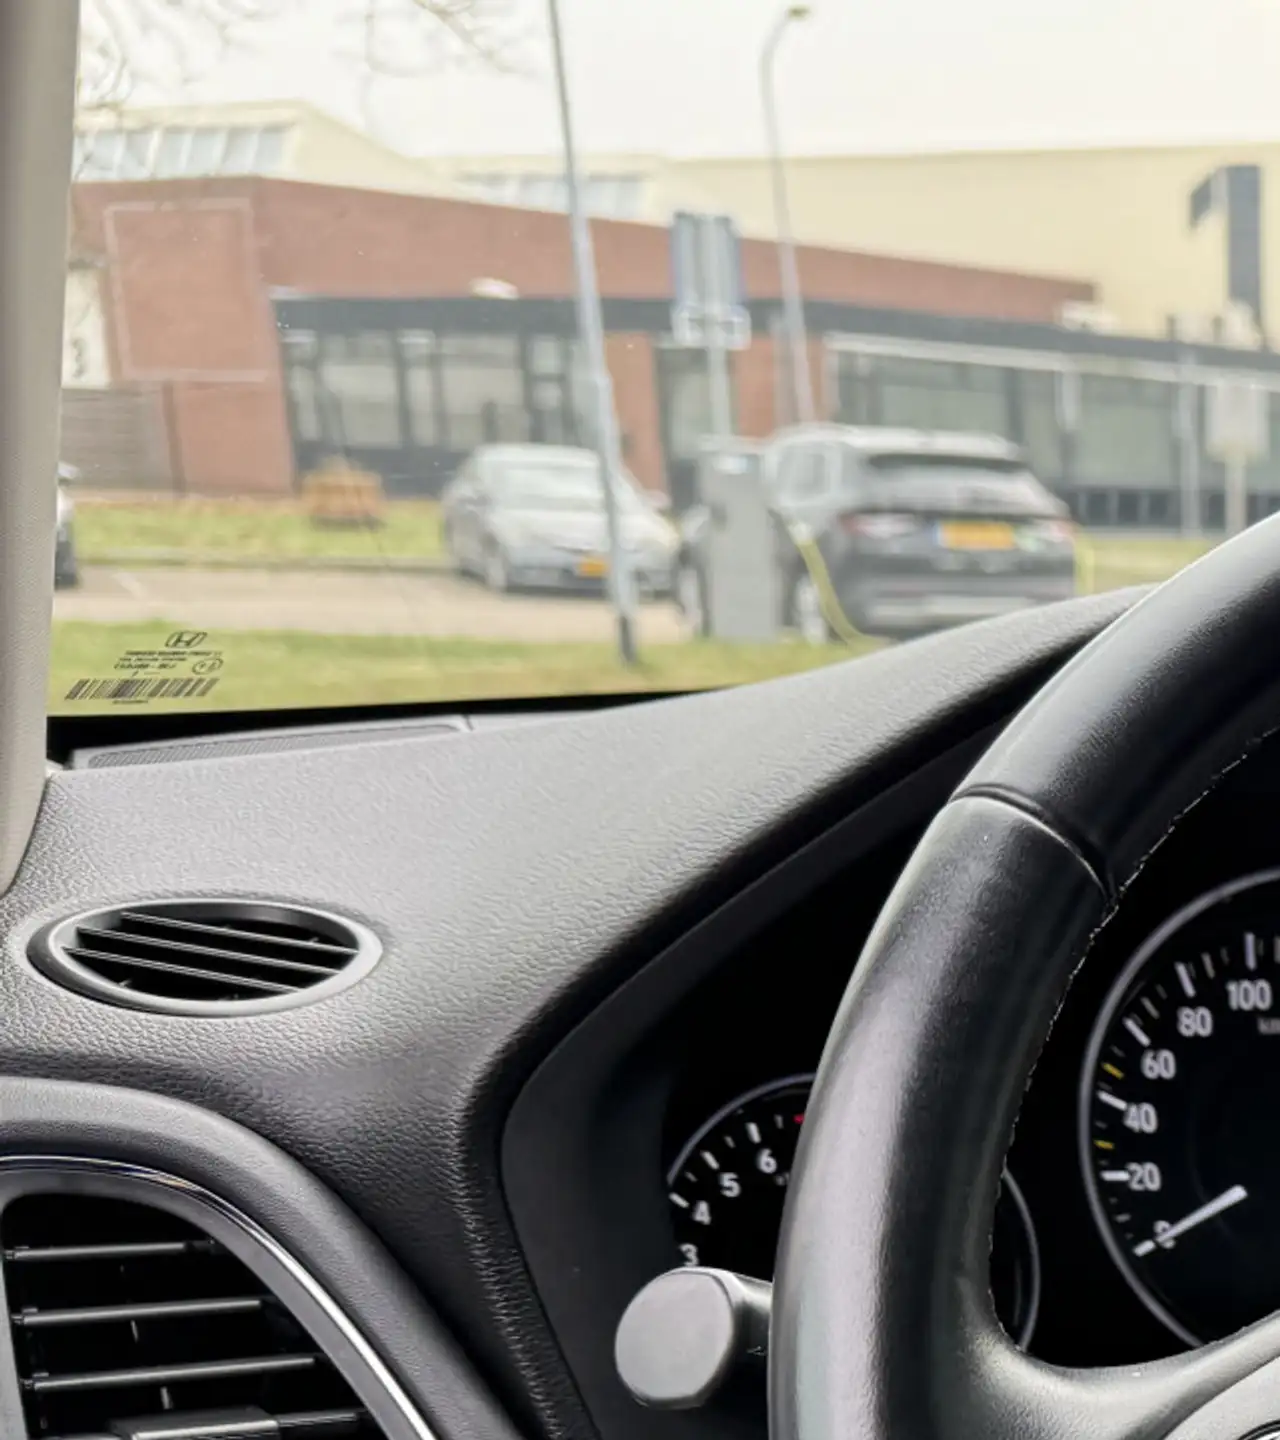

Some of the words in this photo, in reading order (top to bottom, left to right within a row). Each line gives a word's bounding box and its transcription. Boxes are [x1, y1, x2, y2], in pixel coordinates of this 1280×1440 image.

[1226, 979, 1271, 1011] 100
[1177, 1007, 1213, 1036] 80
[1141, 1049, 1176, 1080] 60
[1123, 1103, 1157, 1133] 40
[757, 1149, 778, 1173] 6
[719, 1172, 741, 1197] 5
[1128, 1162, 1161, 1191] 20
[693, 1200, 711, 1225] 4
[679, 1243, 699, 1267] 3
